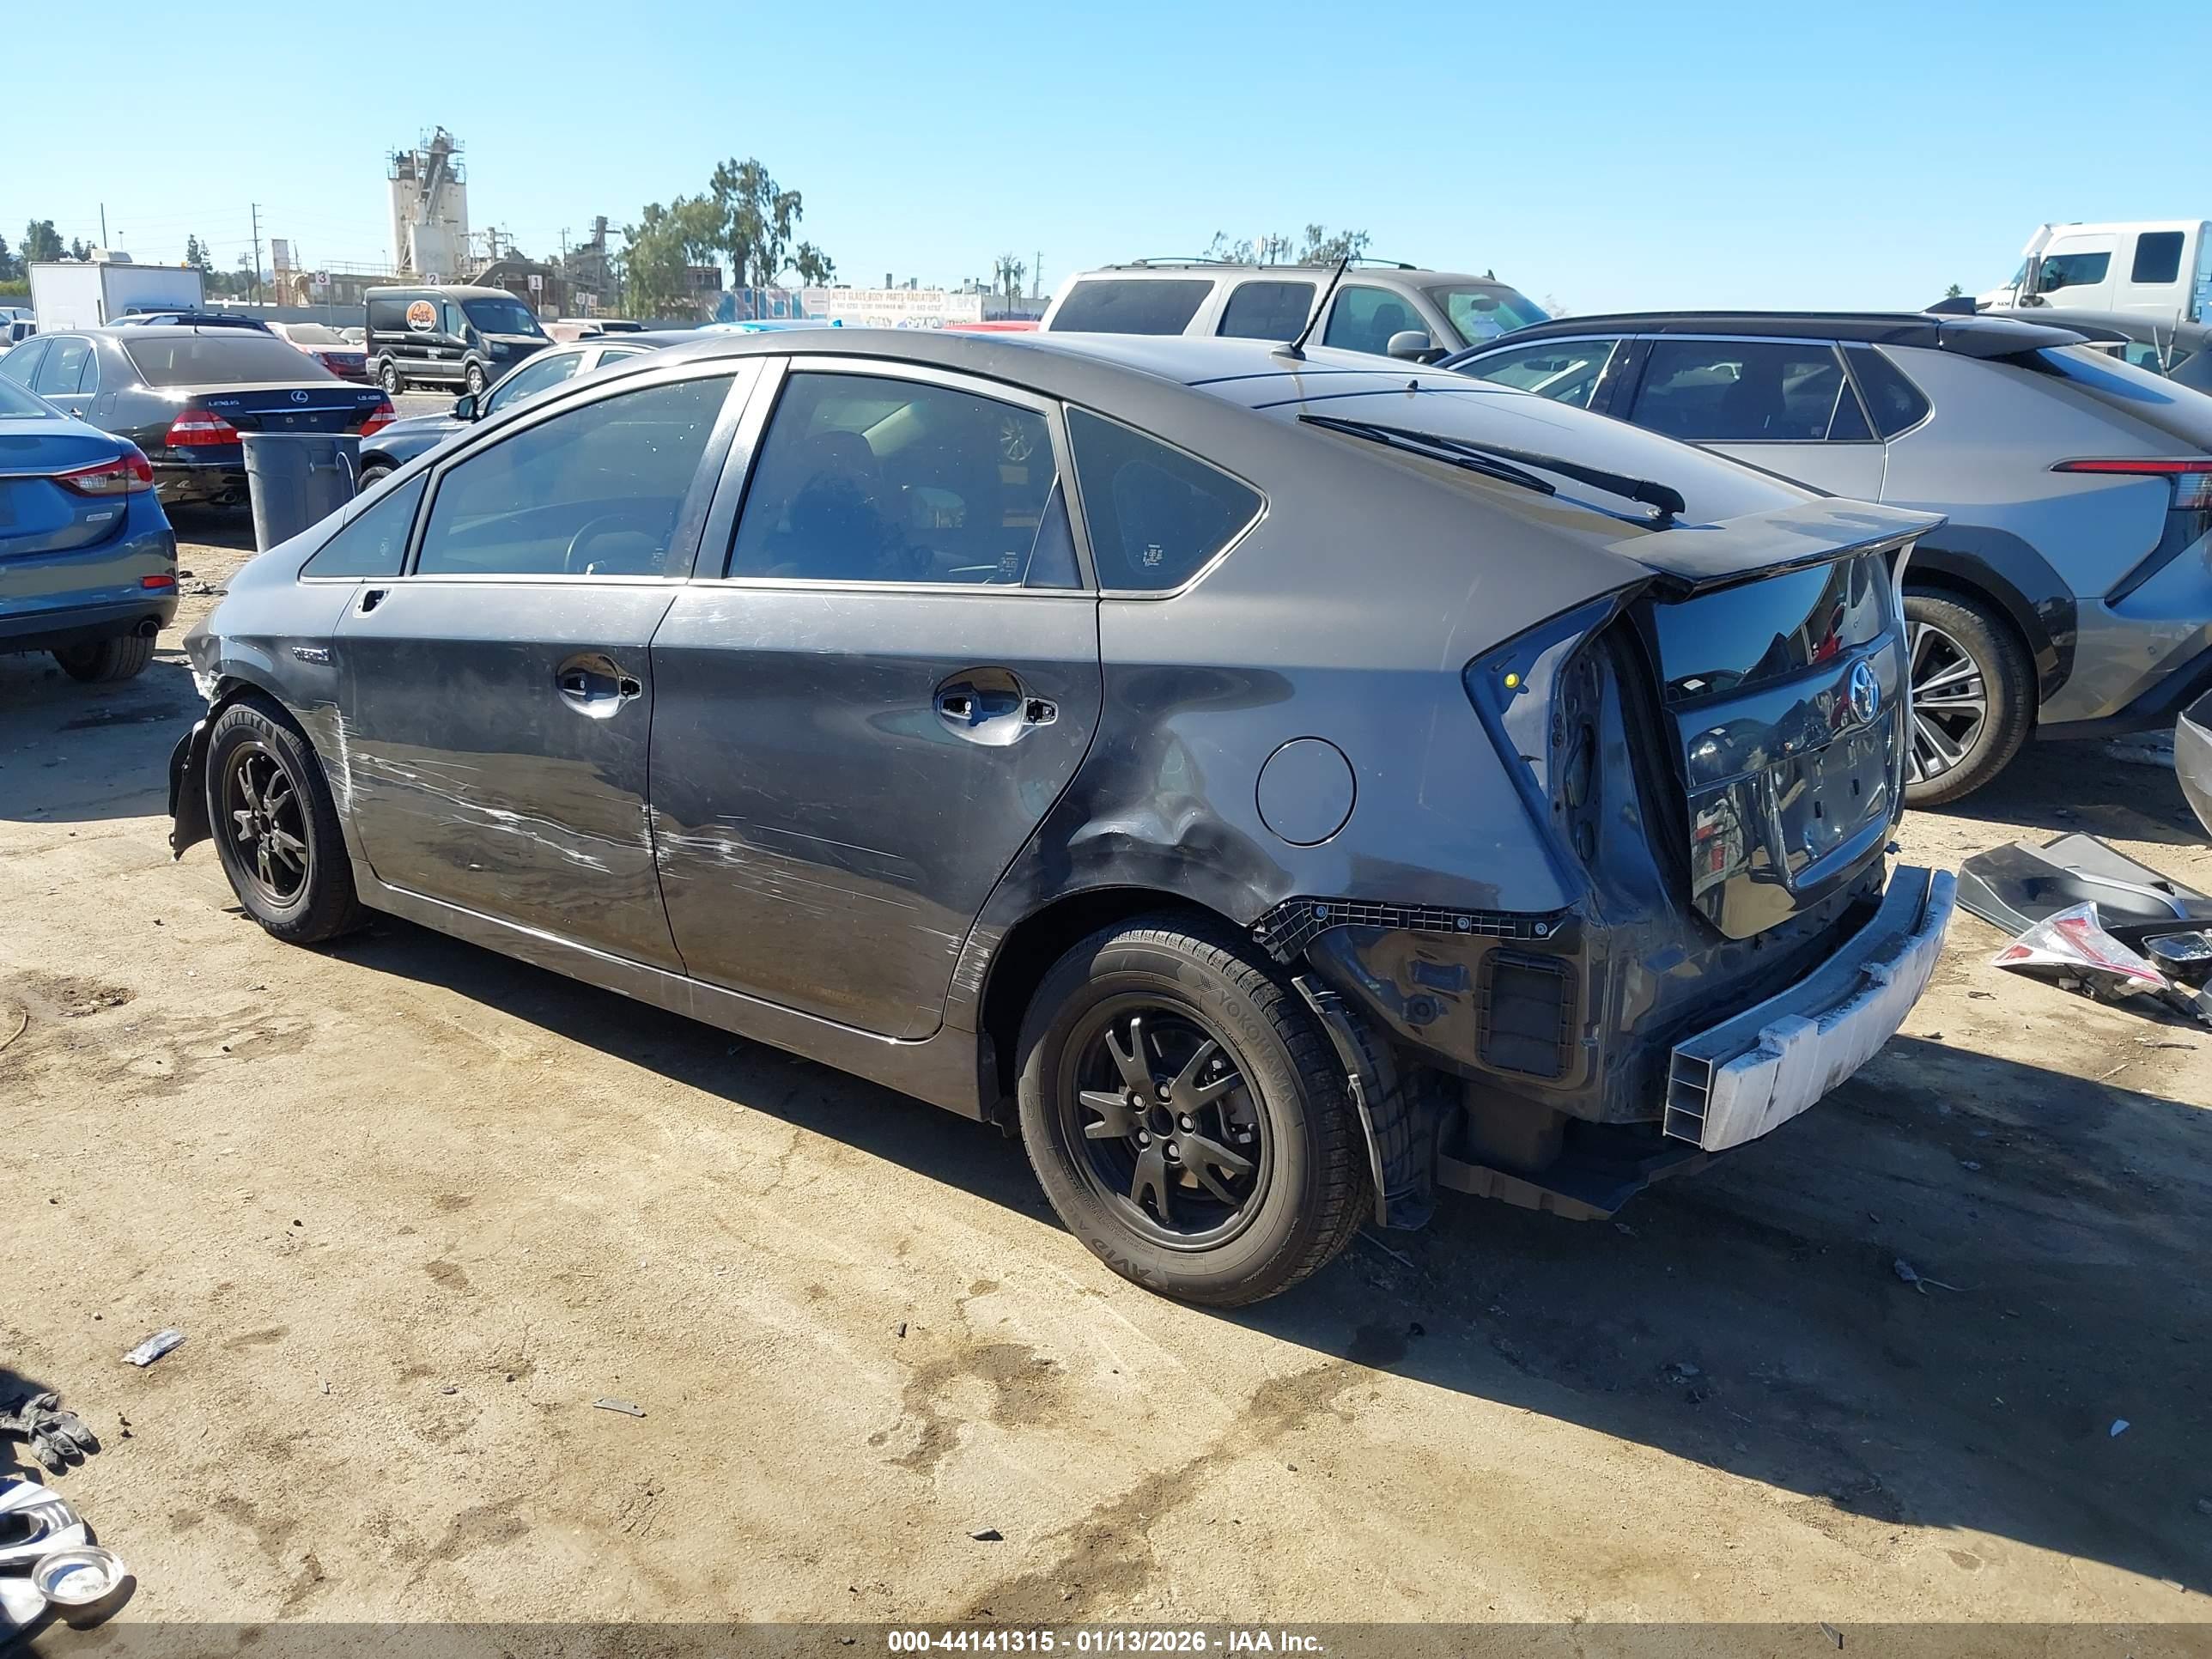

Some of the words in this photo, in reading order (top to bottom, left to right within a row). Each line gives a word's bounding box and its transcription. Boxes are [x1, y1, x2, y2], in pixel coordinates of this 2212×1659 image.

[318, 271, 327, 283] 3
[428, 274, 437, 285] 2
[533, 276, 540, 288] 1
[217, 712, 268, 737] ADVANTA
[1219, 988, 1295, 1103] YOKOHAMA
[1091, 1237, 1153, 1279] AVID
